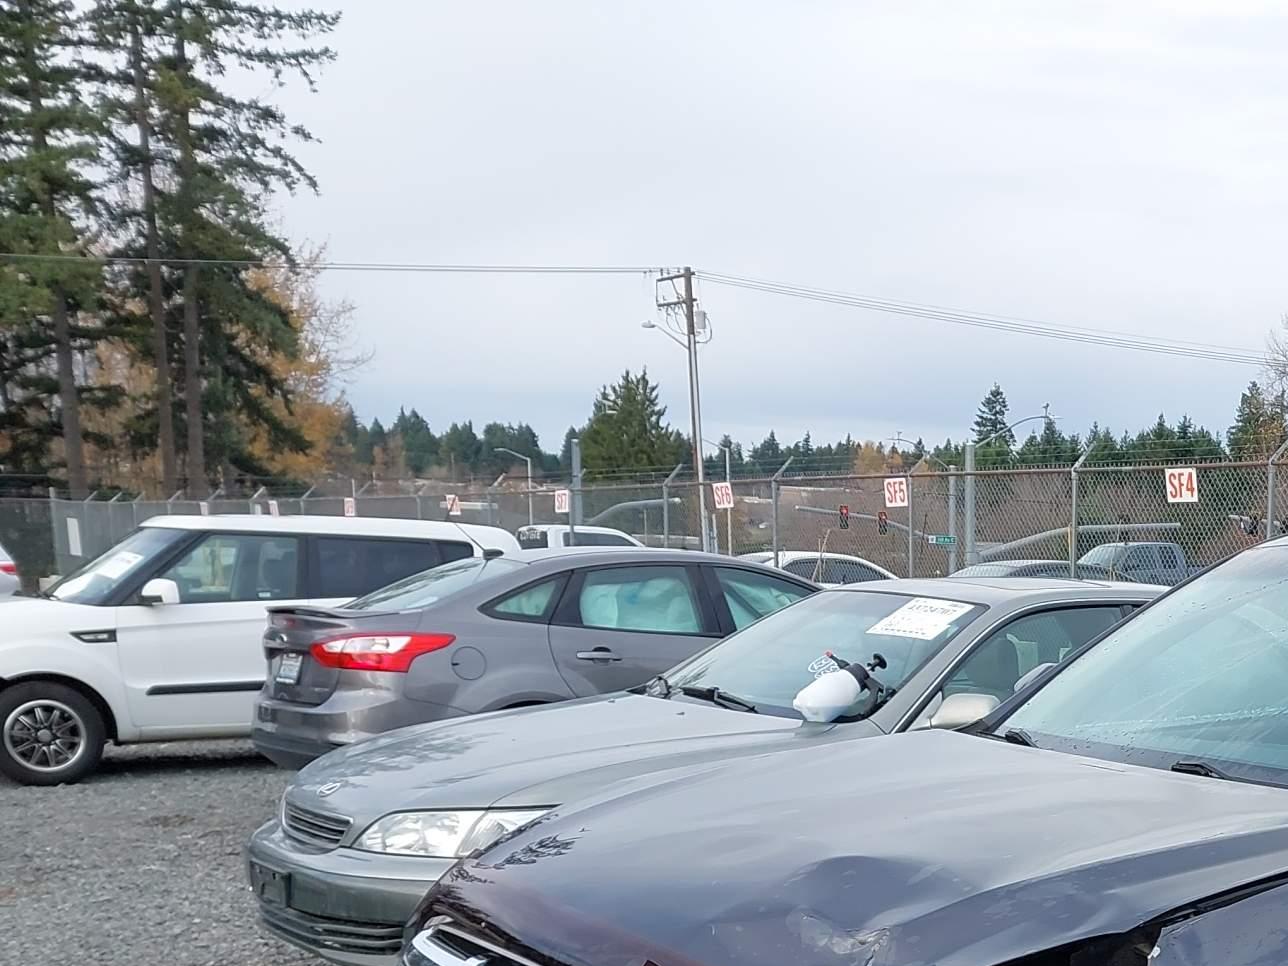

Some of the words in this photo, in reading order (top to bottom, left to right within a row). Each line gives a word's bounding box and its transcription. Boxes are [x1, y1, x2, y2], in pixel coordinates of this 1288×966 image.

[714, 485, 731, 505] SF6
[886, 480, 906, 503] SF5
[1168, 471, 1195, 498] SF4
